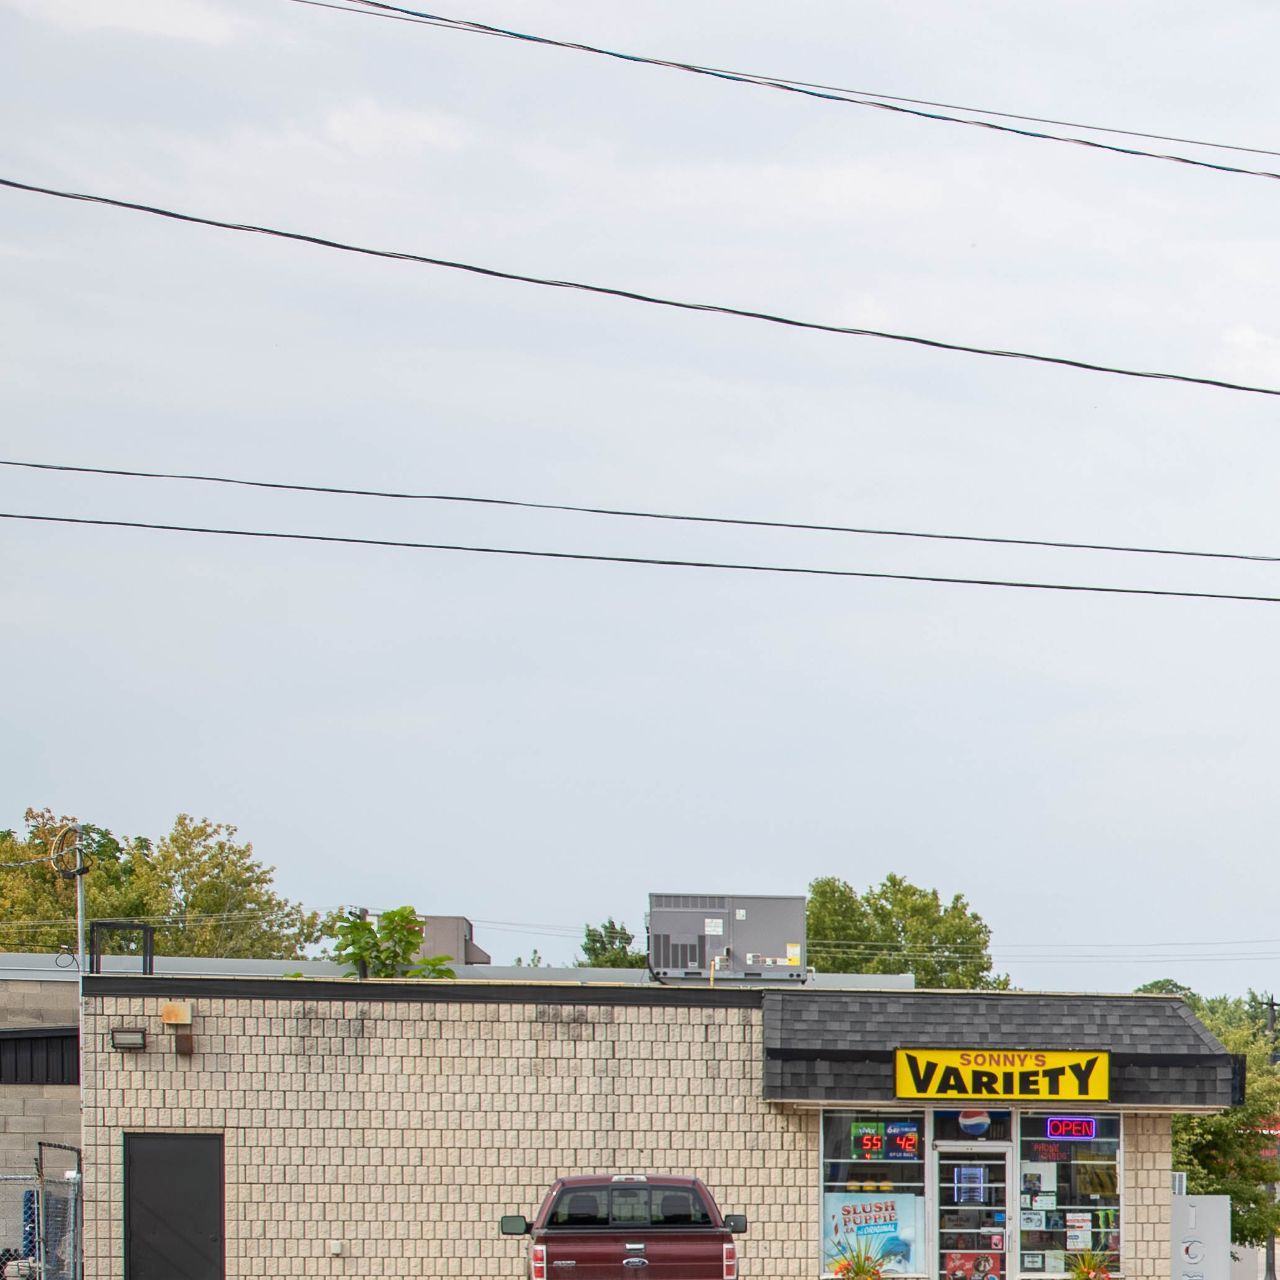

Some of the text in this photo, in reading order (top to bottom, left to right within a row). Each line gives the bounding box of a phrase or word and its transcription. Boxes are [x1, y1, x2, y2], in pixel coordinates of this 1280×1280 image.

[959, 1052, 1047, 1067] SONNY'S
[905, 1052, 1099, 1096] VARIETY
[1050, 1120, 1093, 1136] OPEN
[842, 1200, 896, 1216] SLUSH
[843, 1212, 897, 1227] PUPPIE
